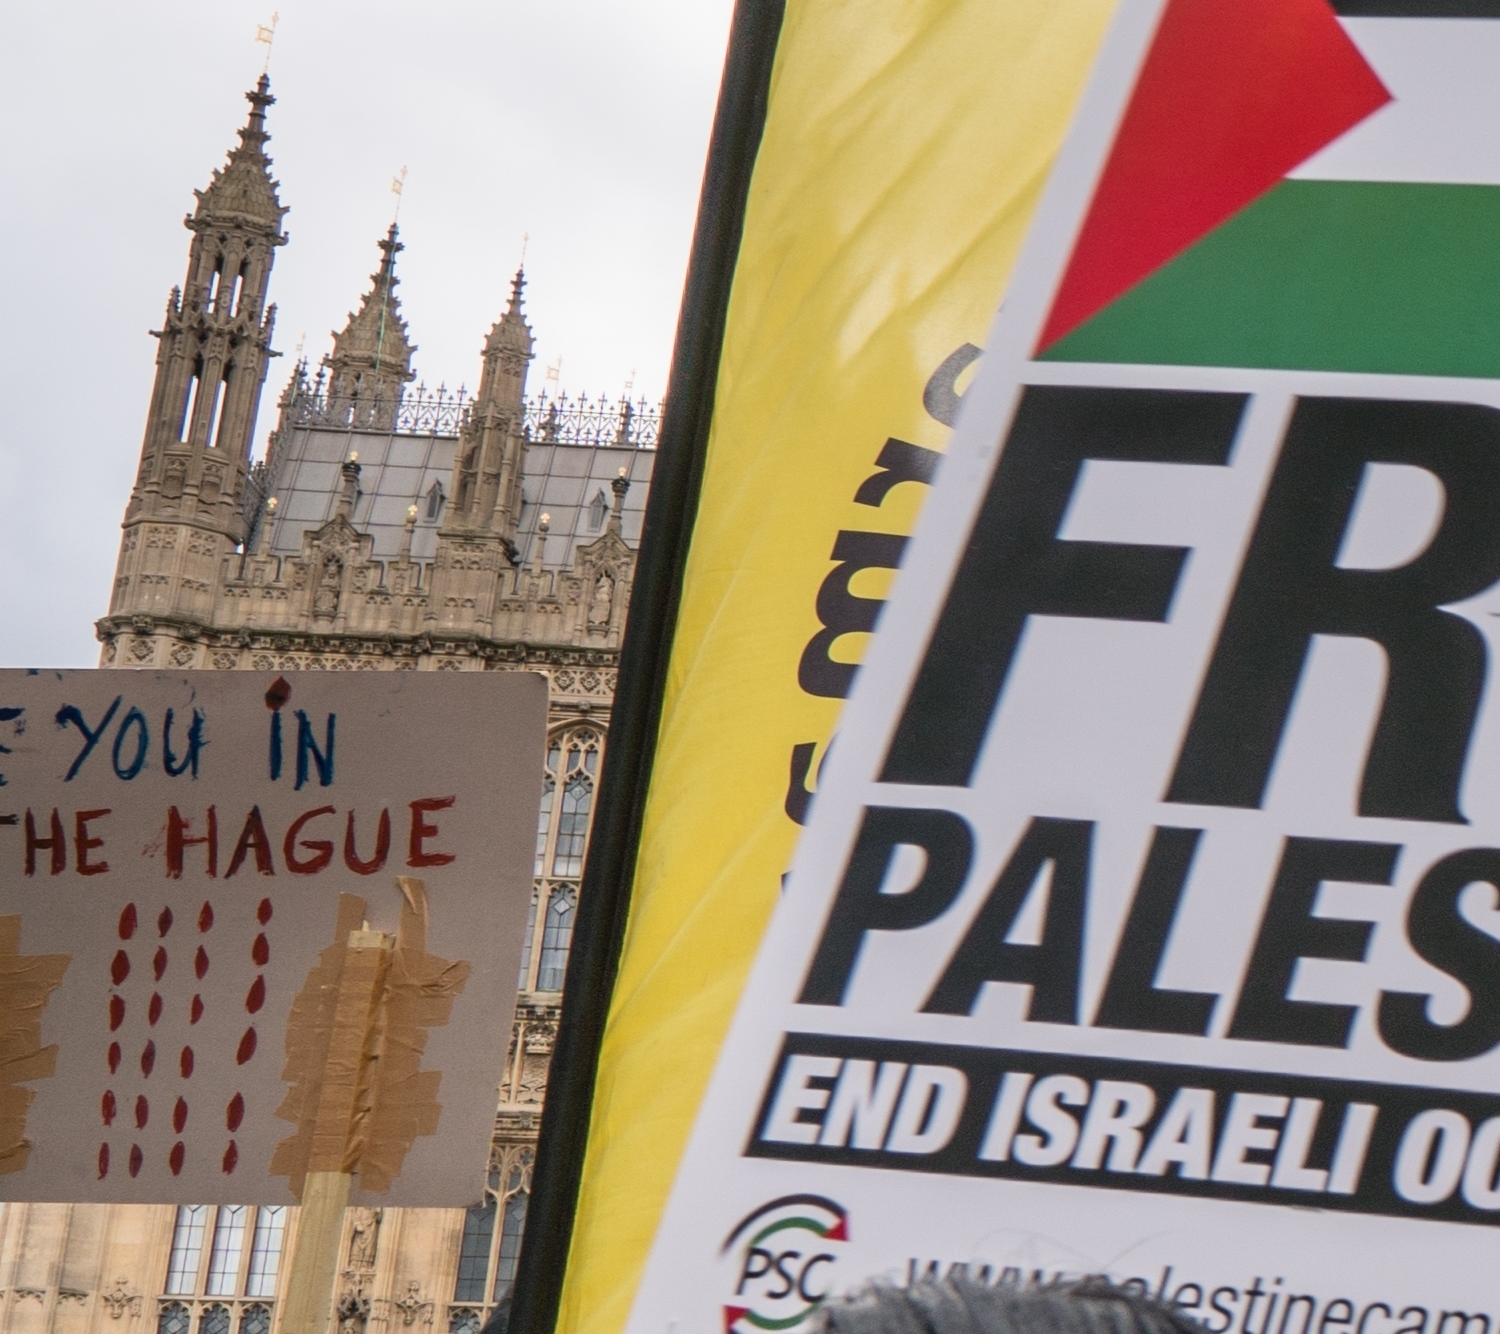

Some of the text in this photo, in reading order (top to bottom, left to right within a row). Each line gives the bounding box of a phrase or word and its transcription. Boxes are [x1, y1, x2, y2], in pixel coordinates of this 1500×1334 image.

[54, 695, 206, 782] YOU
[162, 794, 457, 878] HAGUE
[759, 1053, 968, 1155] END
[978, 1070, 1379, 1195] ISRAELI
[733, 1247, 837, 1304] PSC
